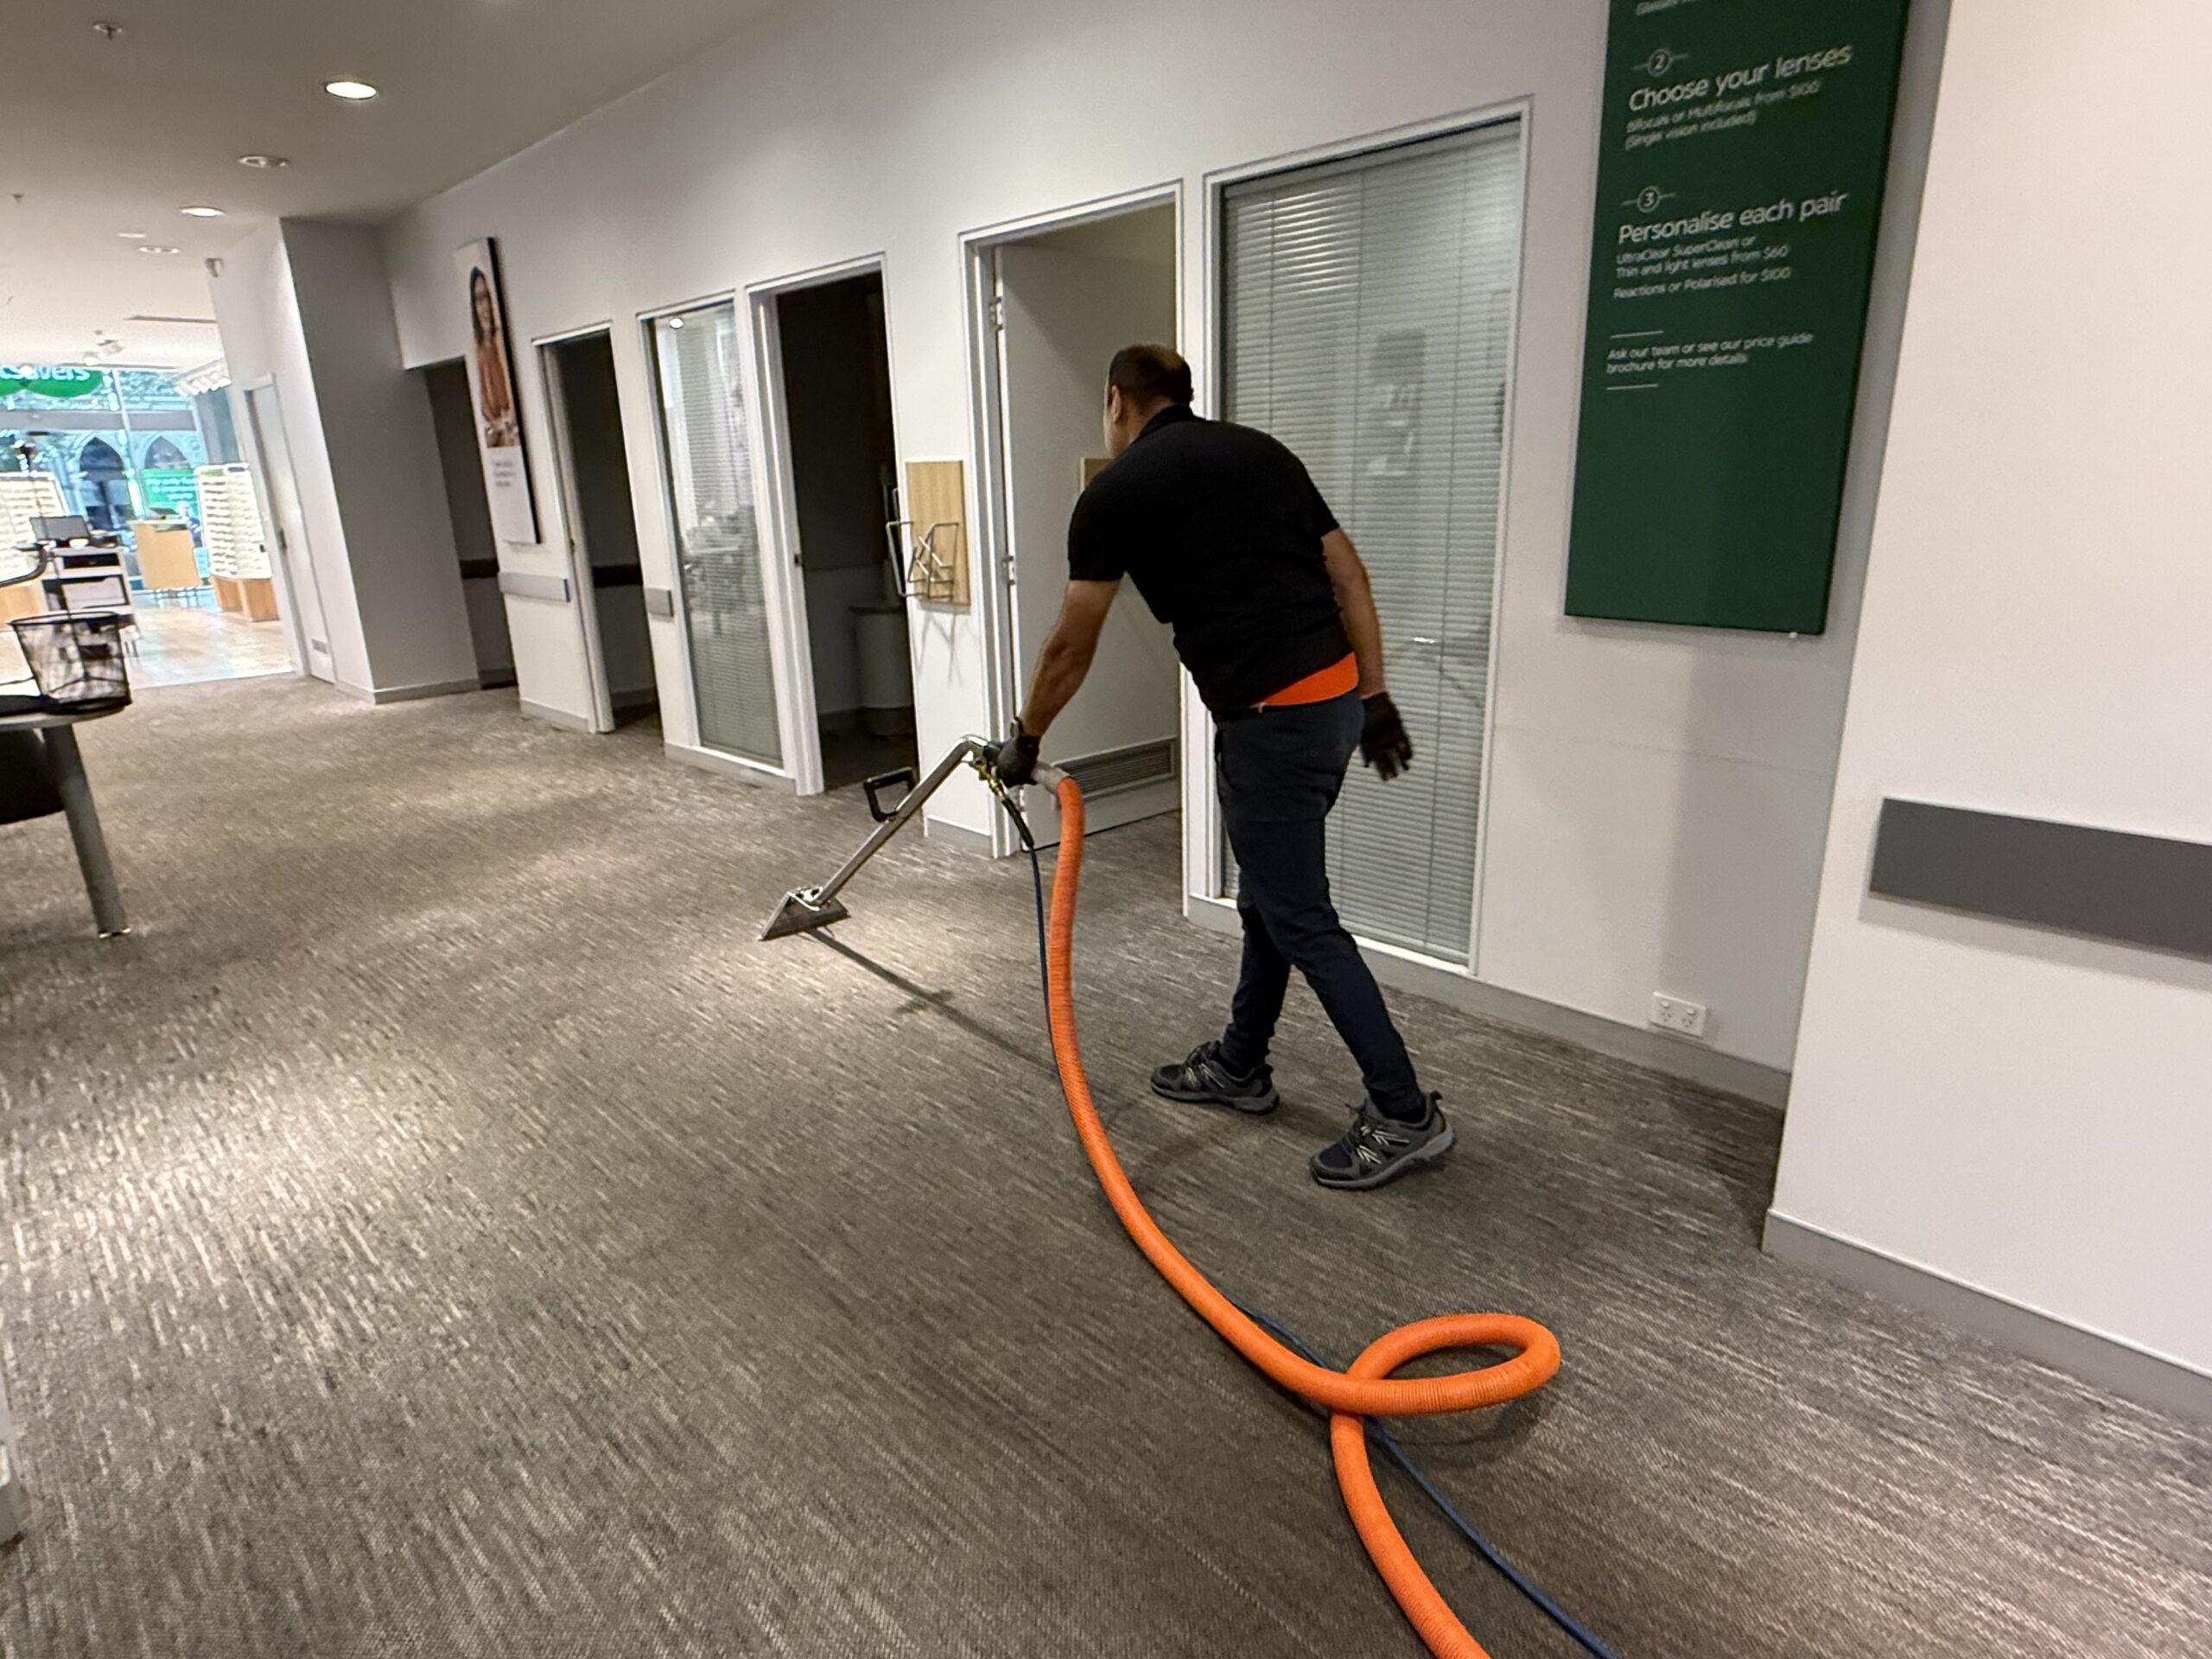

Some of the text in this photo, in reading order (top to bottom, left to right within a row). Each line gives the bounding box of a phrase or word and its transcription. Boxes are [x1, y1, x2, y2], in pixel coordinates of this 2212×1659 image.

[1654, 55, 1664, 70] 2
[1629, 45, 1853, 111] Choose your lenses
[1643, 192, 1655, 207] 3
[1618, 190, 1848, 245] Personalise each pair
[1740, 236, 1756, 247] or
[1616, 266, 1639, 278] Thin
[1640, 263, 1662, 276] and
[1664, 259, 1689, 275] light
[1691, 255, 1729, 269] lenses
[1730, 250, 1762, 263] from
[1668, 282, 1682, 293] or
[1738, 270, 1759, 283] for
[1606, 333, 1814, 360] Ask our team or see our price guide
[1606, 353, 1748, 374] brochure for more details
